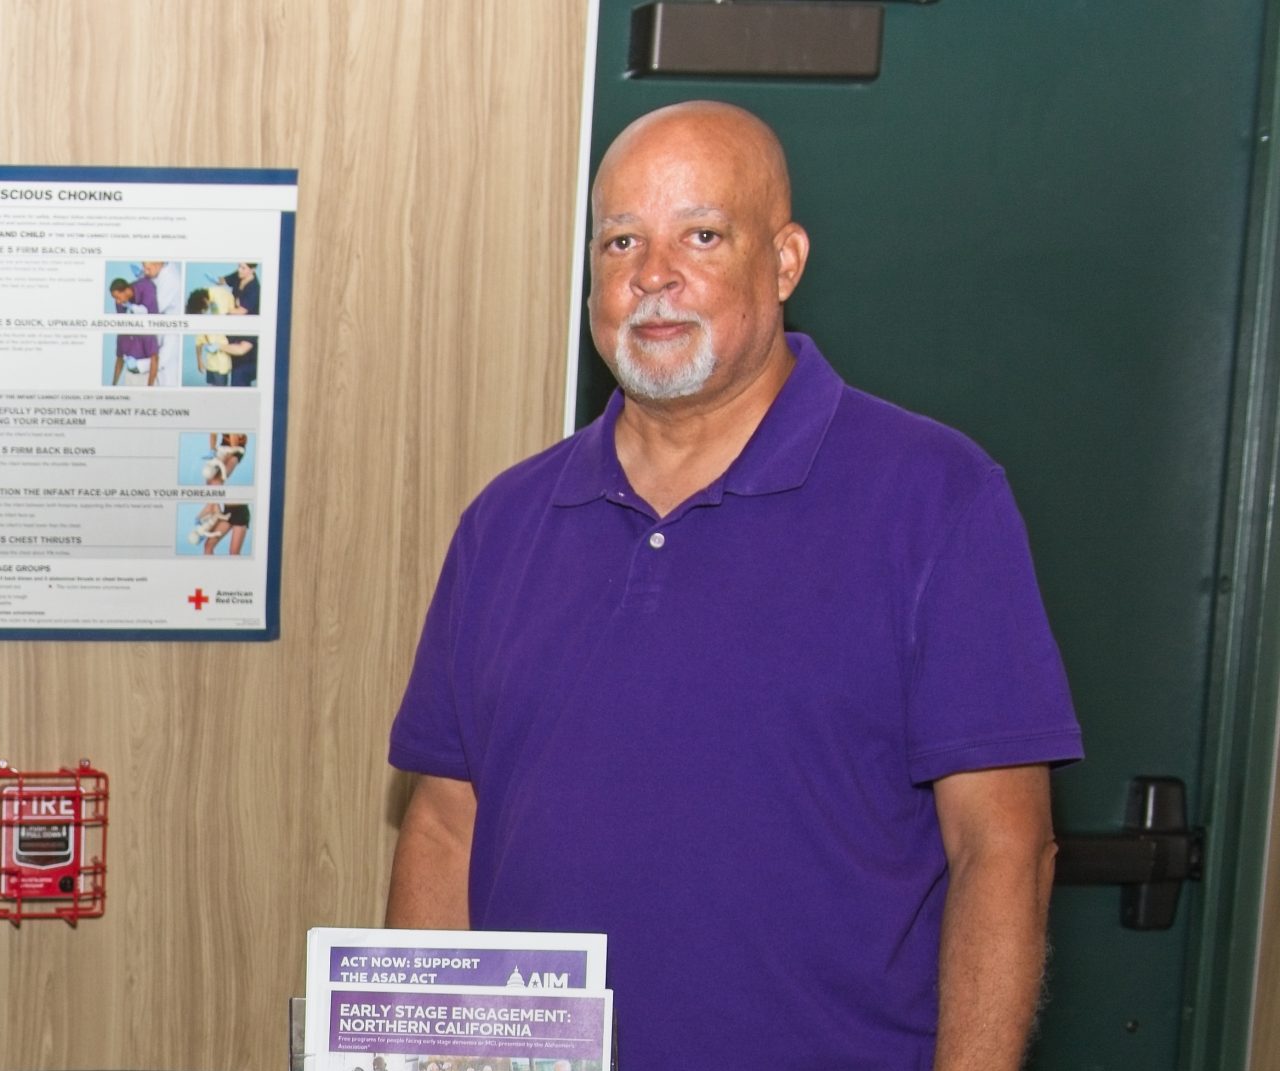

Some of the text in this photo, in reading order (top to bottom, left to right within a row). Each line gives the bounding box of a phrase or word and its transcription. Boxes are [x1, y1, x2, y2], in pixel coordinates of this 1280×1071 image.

[58, 190, 123, 201] CHOKING
[16, 246, 38, 254] FIRM
[14, 319, 44, 327] QUICK,
[90, 320, 144, 328] ABDOMINAL
[148, 320, 189, 328] THRUSTS
[34, 407, 77, 415] POSITION
[100, 408, 132, 416] INFANT
[134, 408, 190, 416] FACE-DOWN
[2, 446, 8, 454] 5
[63, 447, 96, 455] BLOWS
[24, 488, 40, 496] THE
[43, 488, 75, 496] INFANT
[78, 488, 118, 496] FACE-UP
[154, 489, 178, 497] YOUR
[181, 489, 226, 497] FOREARM
[8, 536, 38, 544] CHEST
[40, 536, 82, 544] THRUSTS
[16, 564, 51, 572] GROUPS
[13, 796, 75, 816] FIRE
[340, 957, 480, 969] ACT NOW: SUPPORT
[340, 972, 438, 984] THE ASAP ACT
[528, 972, 569, 989] AIM
[340, 1004, 572, 1024] EARLY STAGE ENGAGEMENT:
[339, 1018, 532, 1037] NORTHERN CALIFORNIA
